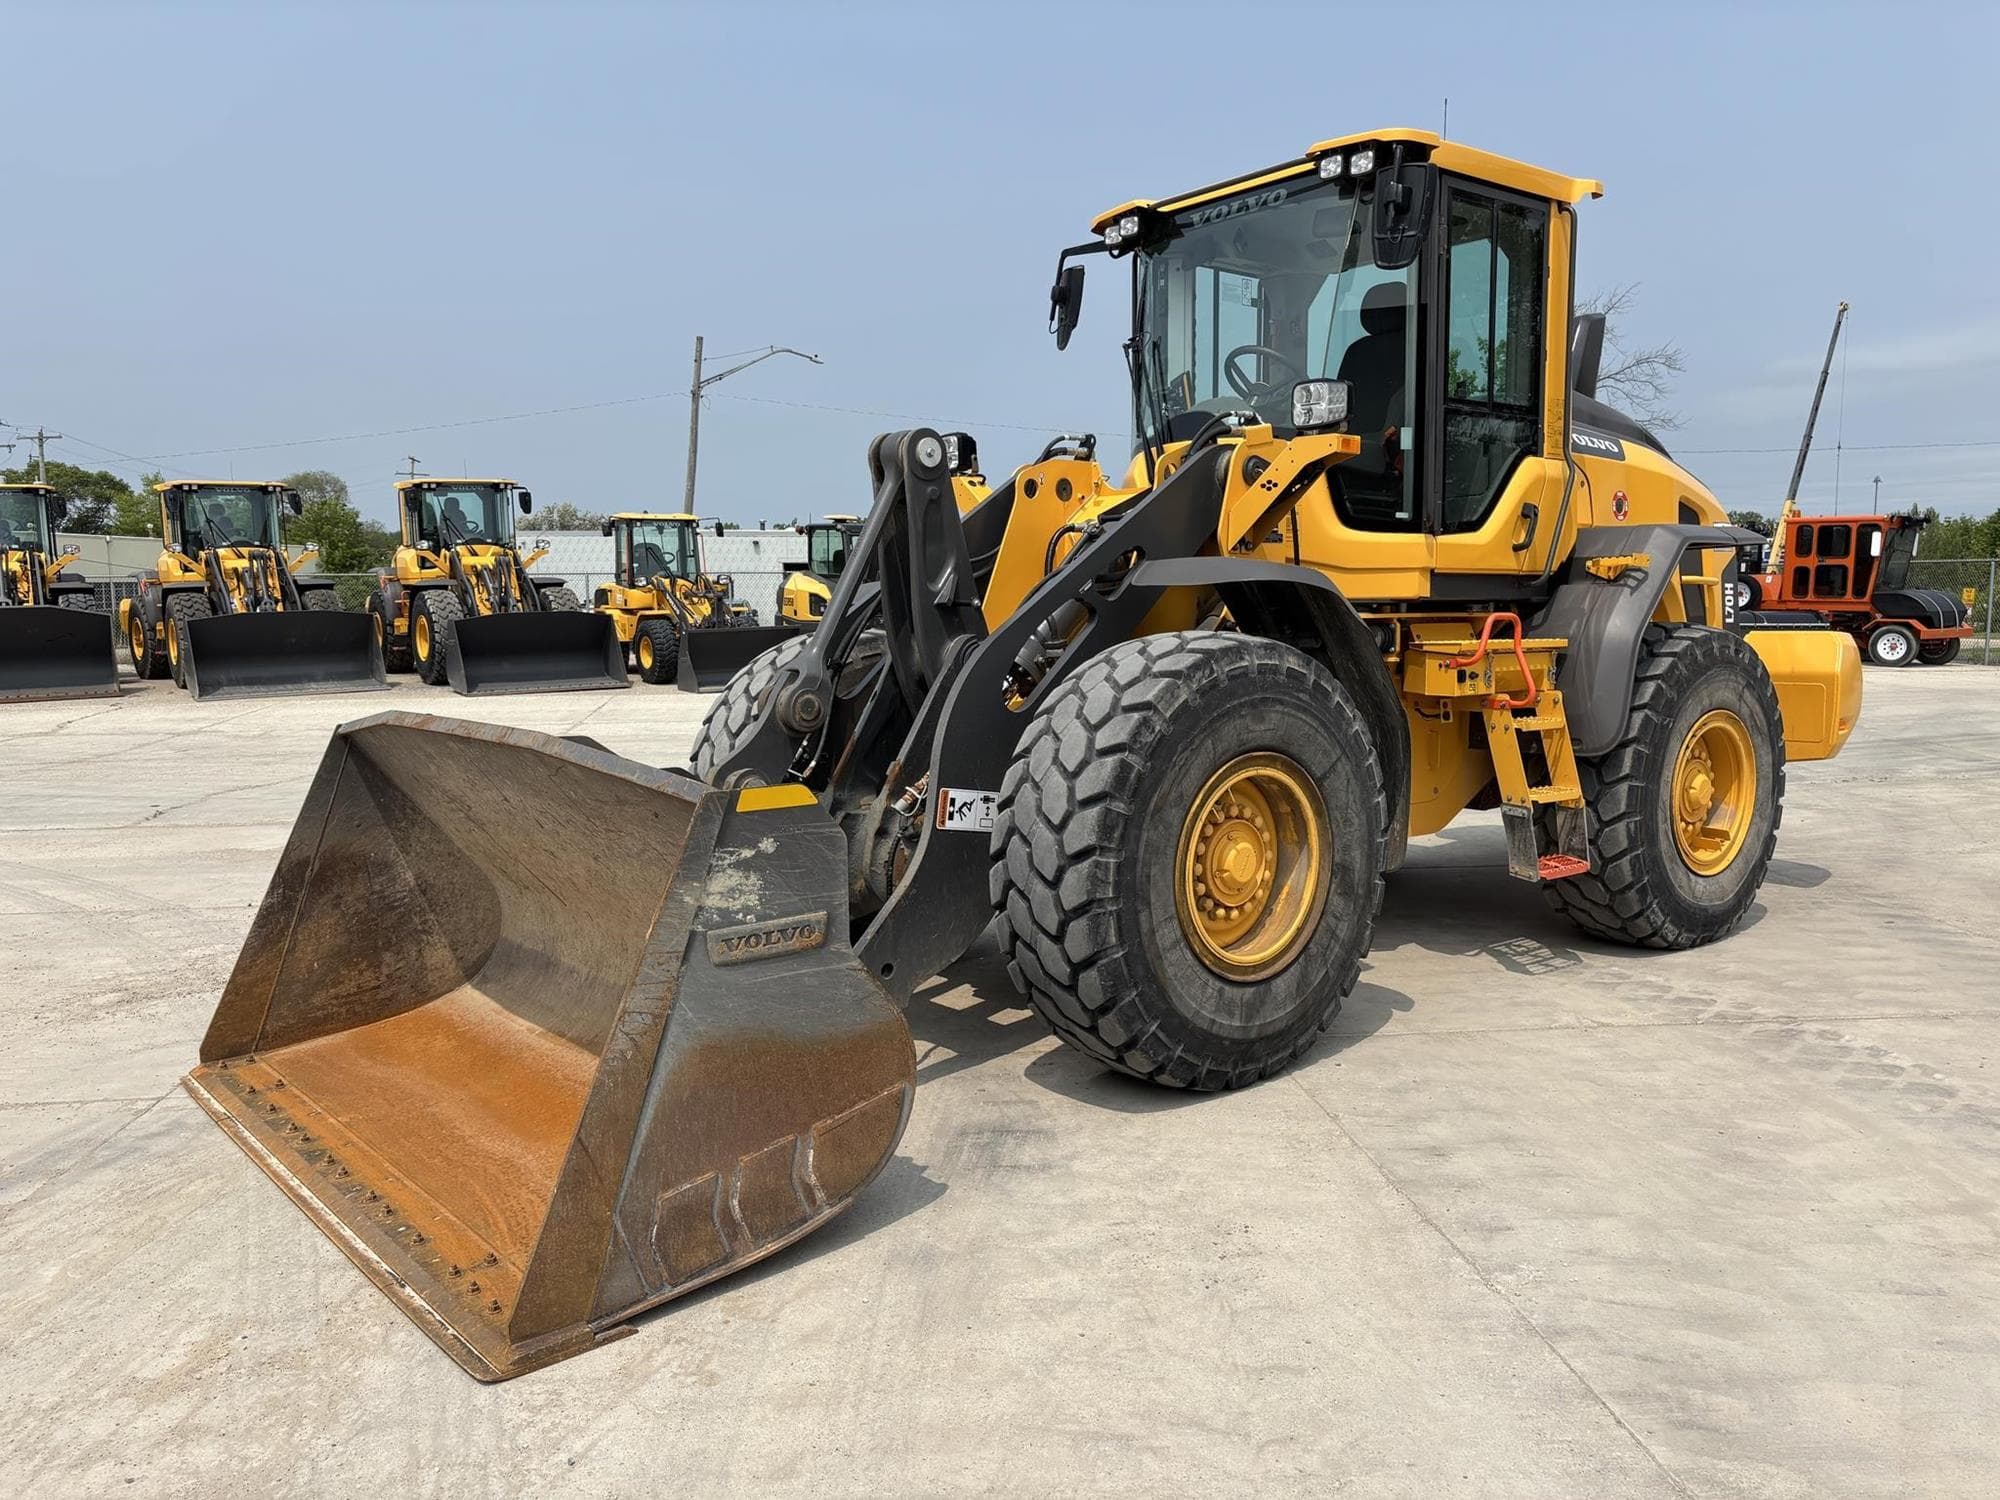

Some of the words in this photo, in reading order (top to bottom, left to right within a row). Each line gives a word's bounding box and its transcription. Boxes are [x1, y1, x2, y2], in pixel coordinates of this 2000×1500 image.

[1190, 189, 1288, 228] VOLVO
[1571, 433, 1619, 452] OLVO
[1724, 583, 1735, 623] L70H
[721, 924, 817, 953] VOLVO
